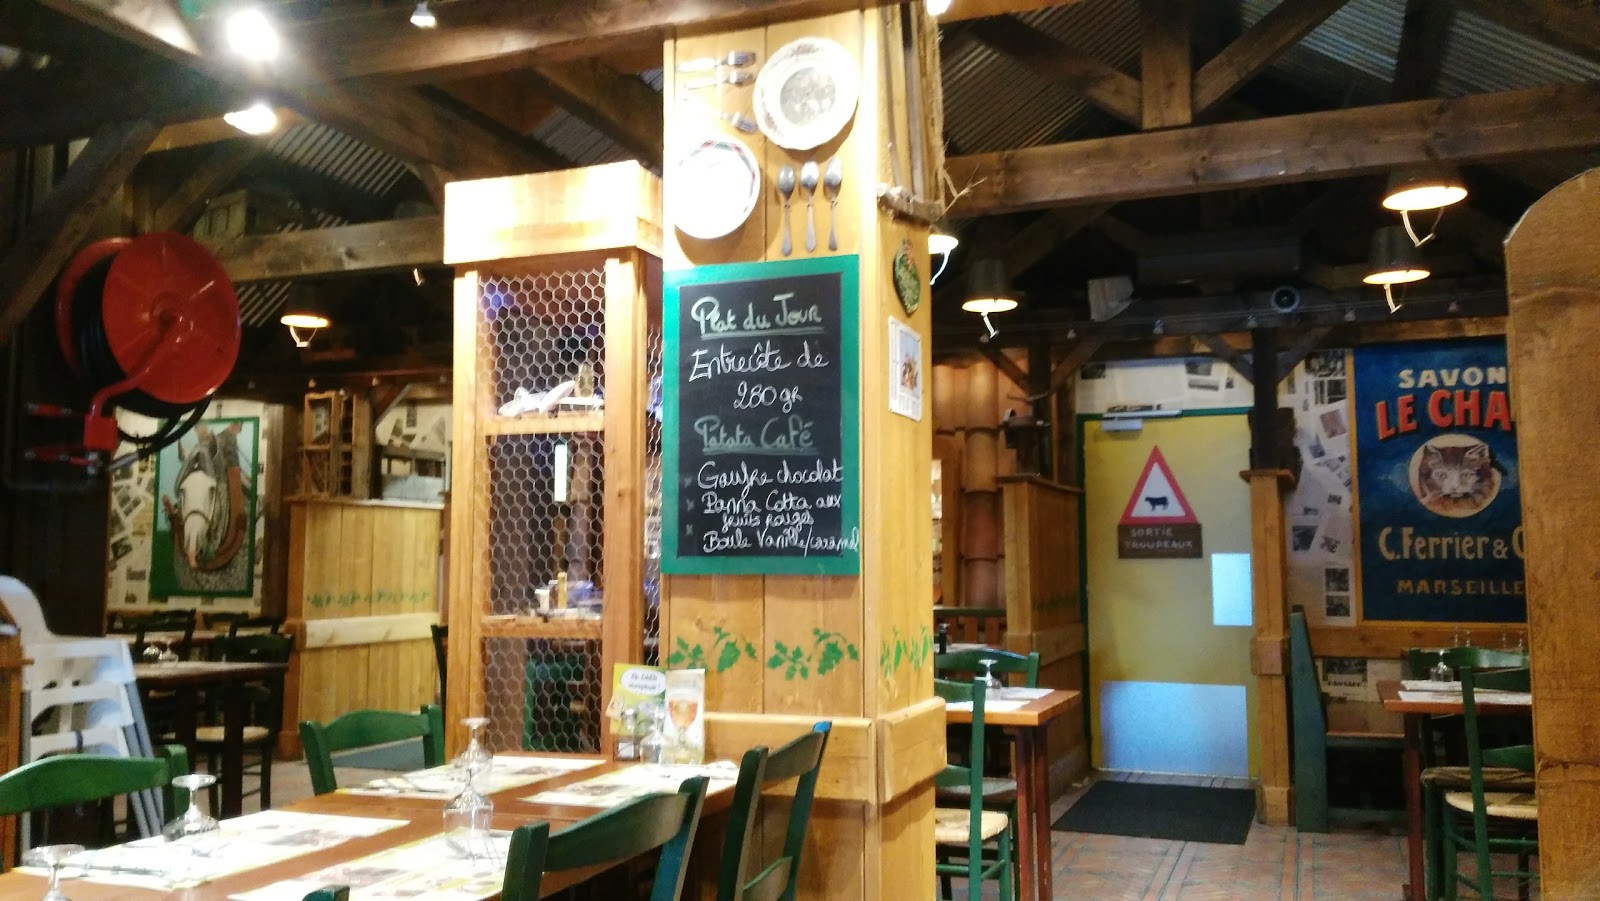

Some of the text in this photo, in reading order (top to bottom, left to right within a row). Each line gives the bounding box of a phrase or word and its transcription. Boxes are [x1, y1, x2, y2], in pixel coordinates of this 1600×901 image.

[691, 292, 822, 334] Plat du Jour
[797, 340, 830, 368] de
[1398, 366, 1506, 388] SAVON
[1376, 388, 1511, 441] LE CHA
[761, 413, 814, 451] Café
[697, 458, 844, 498] Gaufre chocolat
[702, 489, 842, 515] Panna Cotta aux
[722, 509, 815, 534] fruits rouges
[703, 528, 752, 554] Boule
[1123, 539, 1193, 550] TROUPEAUX
[1491, 538, 1508, 560] &
[1396, 579, 1525, 596] MARSEILLE
